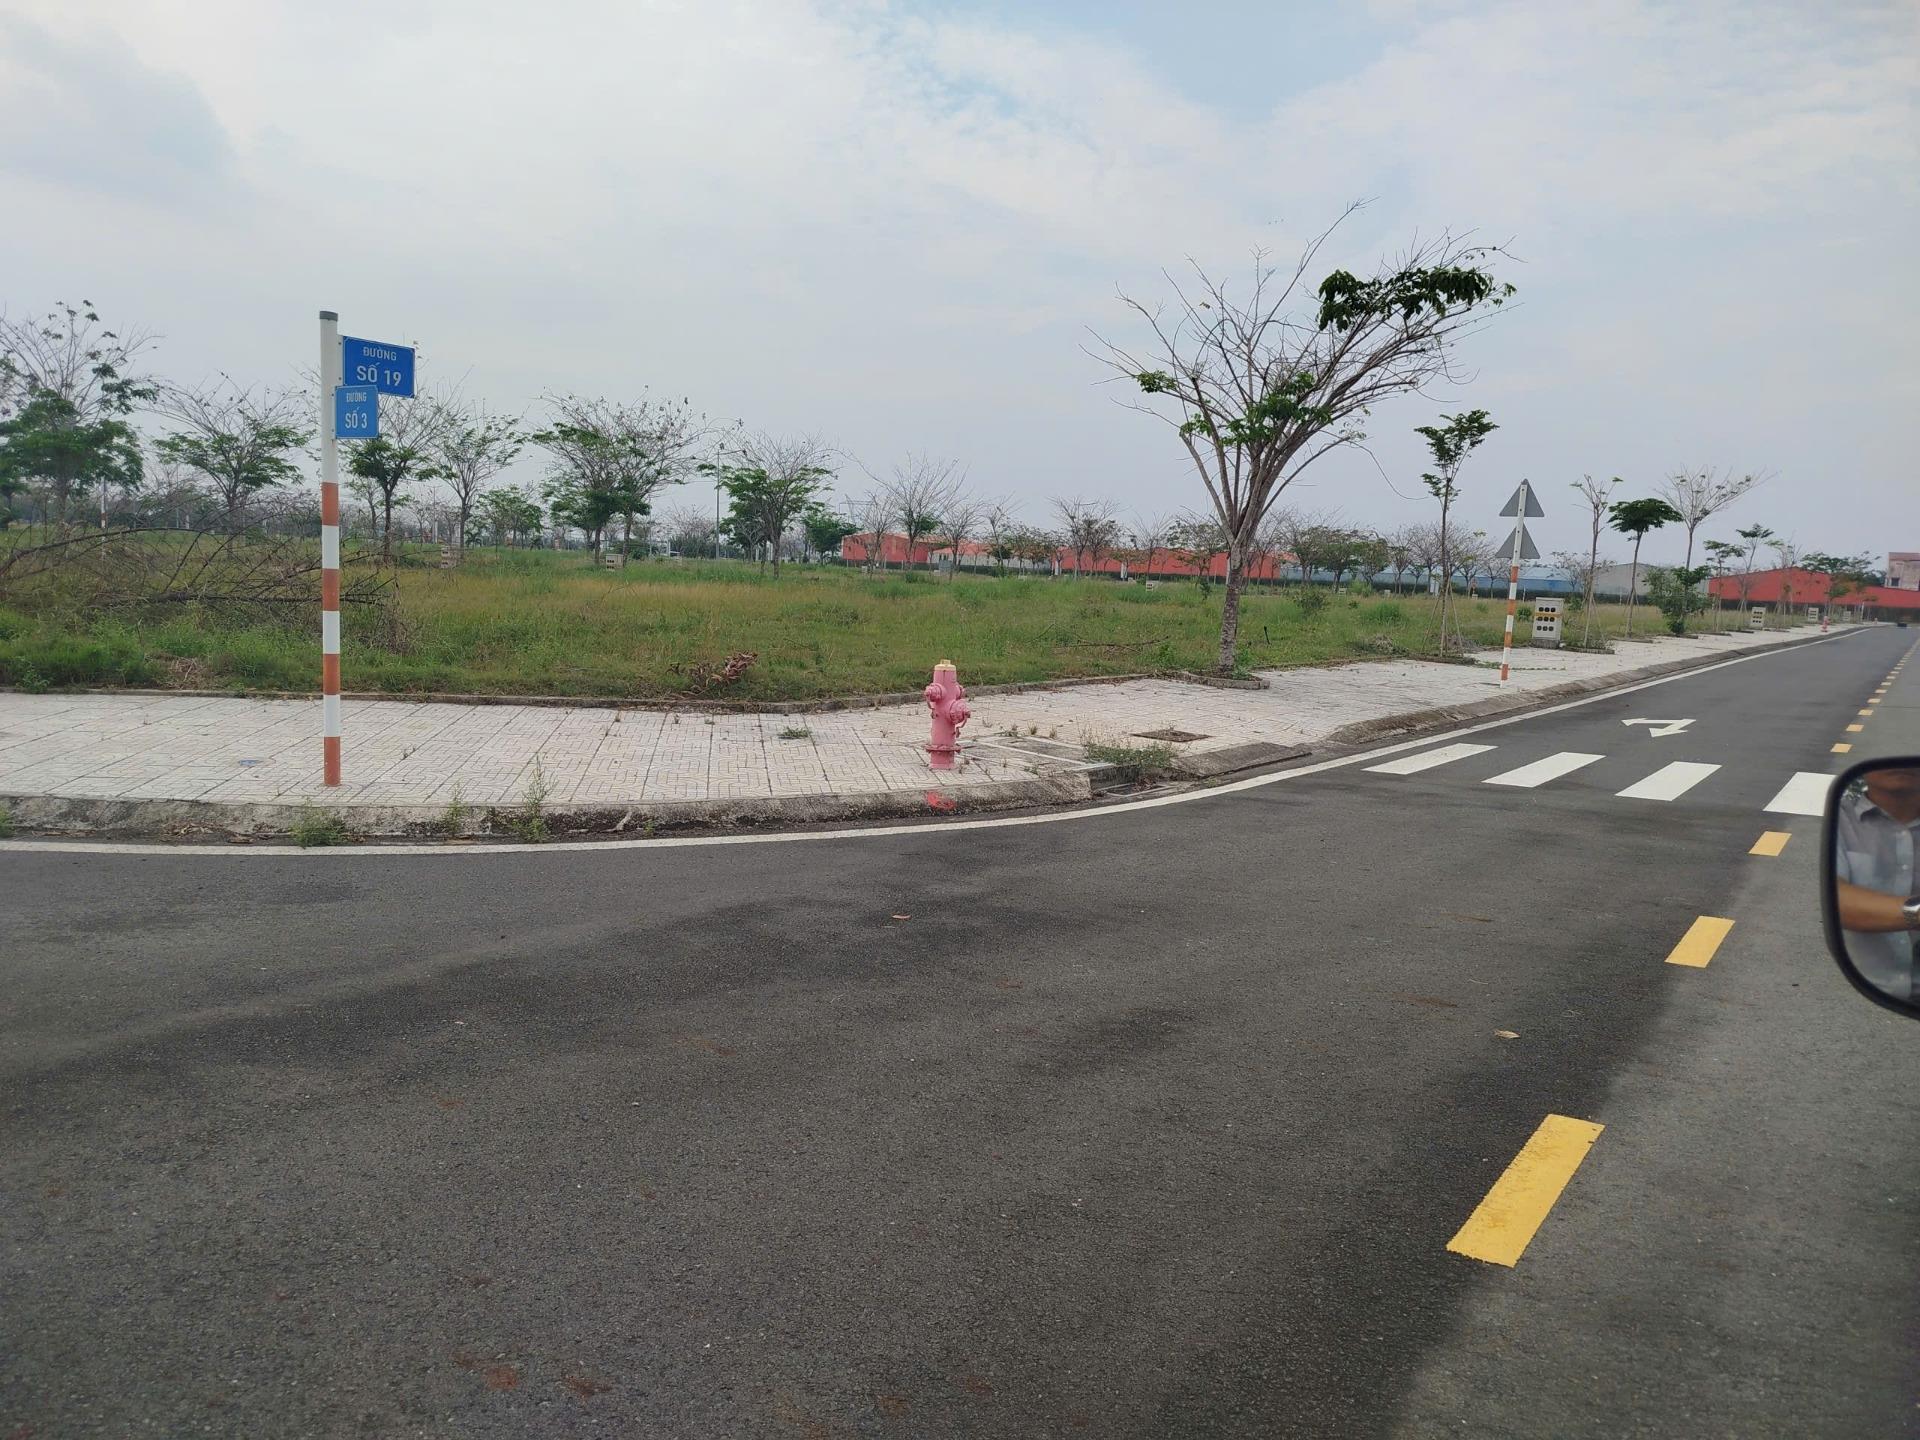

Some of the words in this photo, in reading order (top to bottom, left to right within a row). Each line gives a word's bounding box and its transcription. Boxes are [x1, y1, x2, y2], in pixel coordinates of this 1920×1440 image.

[356, 362, 380, 383] SỐ
[384, 369, 402, 386] 19
[345, 406, 360, 429] SỐ
[361, 412, 368, 429] 3
